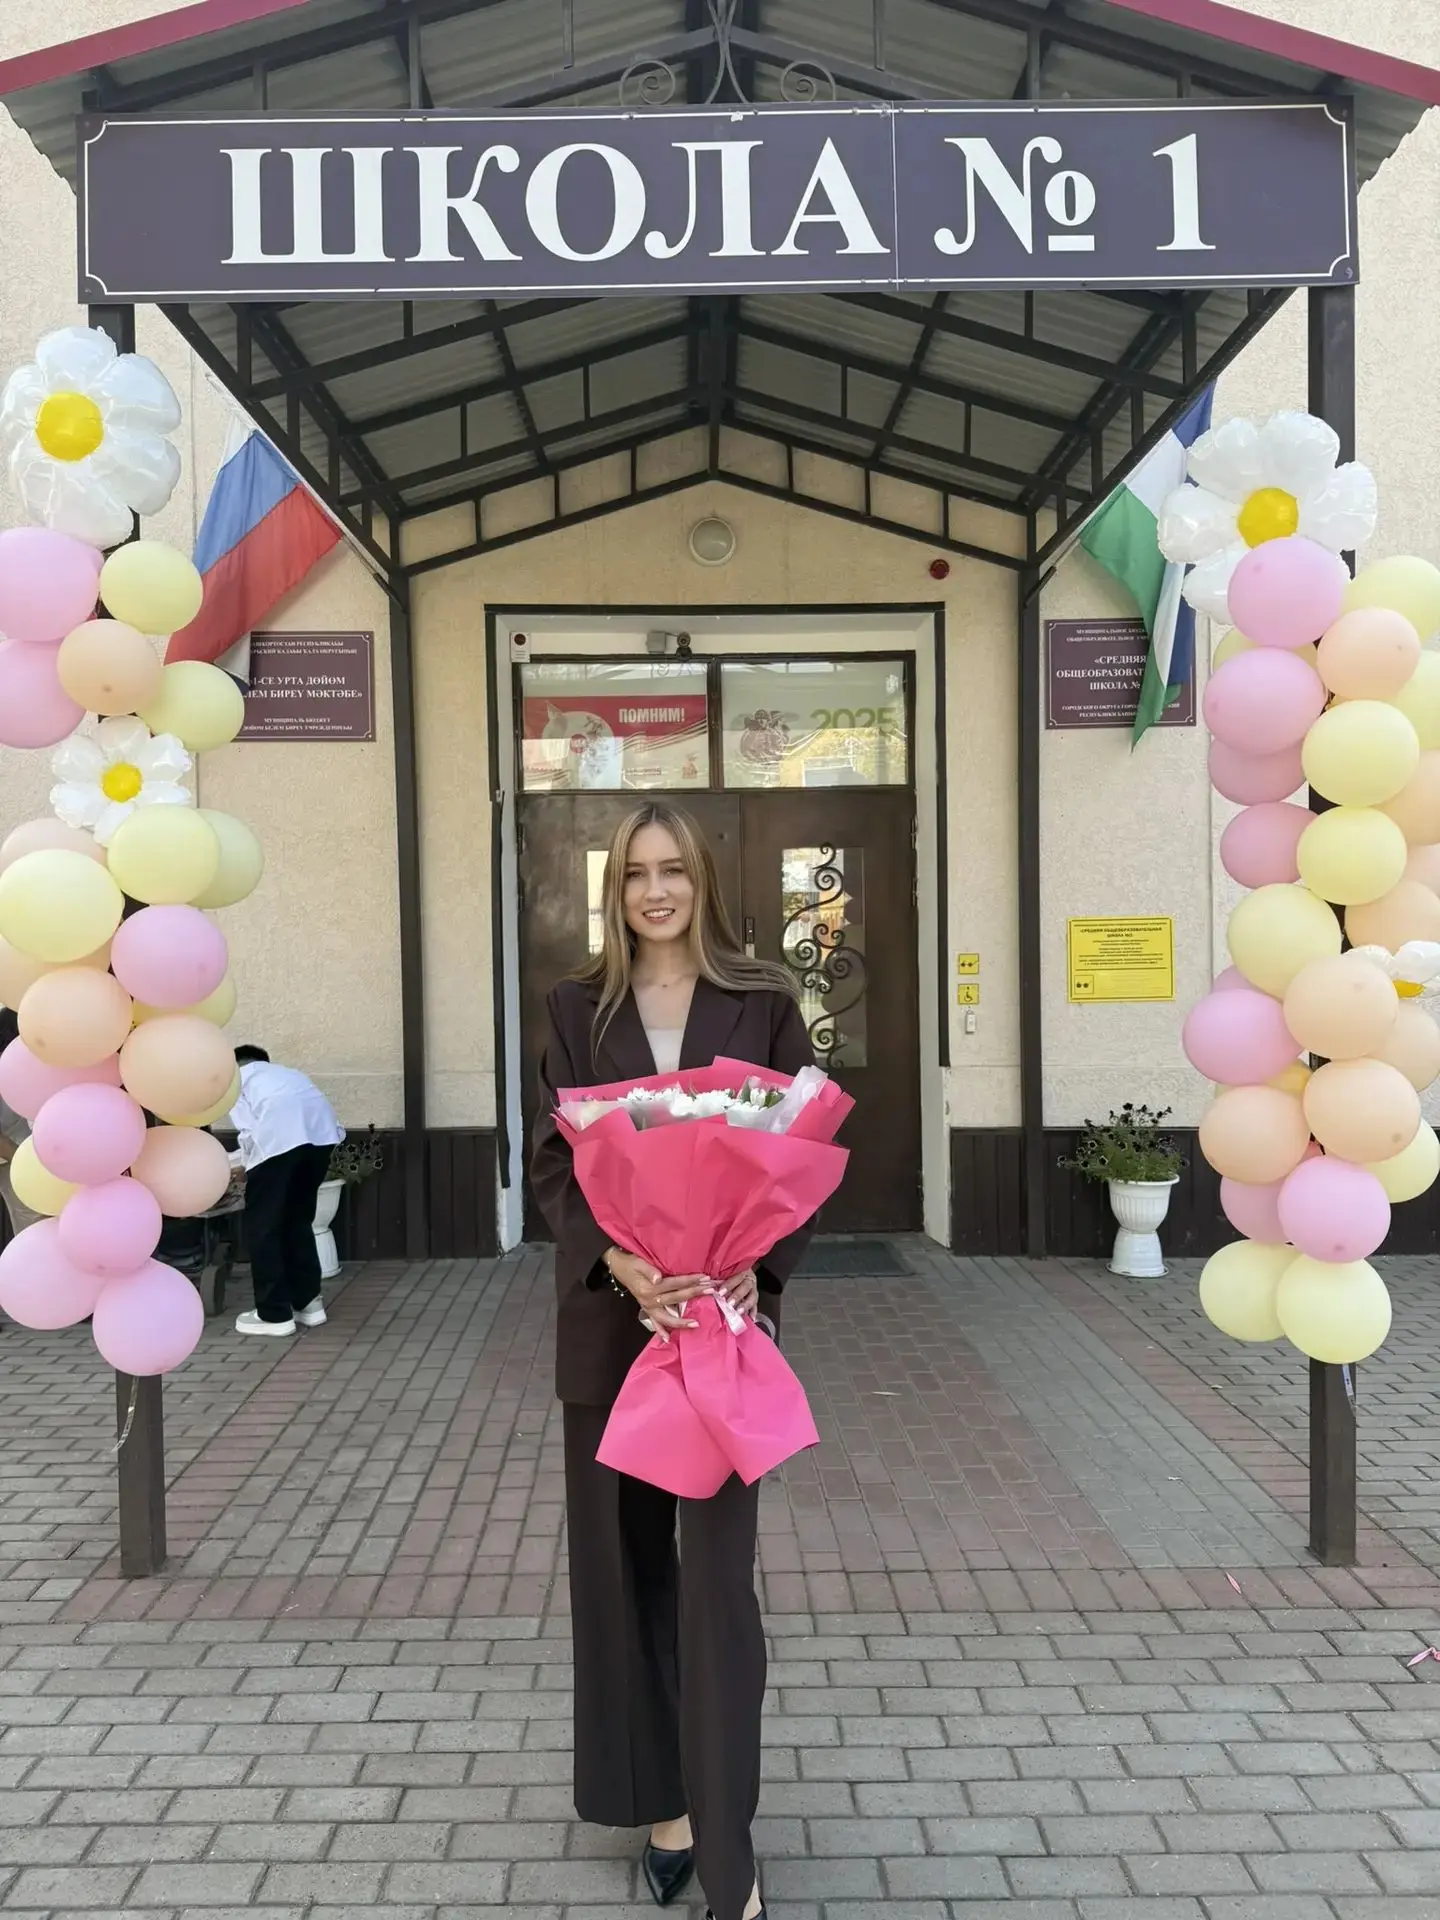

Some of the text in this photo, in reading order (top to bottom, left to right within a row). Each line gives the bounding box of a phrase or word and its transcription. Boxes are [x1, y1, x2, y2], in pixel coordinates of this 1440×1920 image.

[219, 132, 1217, 265] ШКОЛА № 1
[1094, 655, 1146, 664] «СРЕДНЯЯ
[1056, 668, 1143, 678] ОБЩЕОБРАЗОВАТ
[277, 676, 304, 685] УРТА
[1090, 681, 1128, 690] ШКОЛА
[619, 707, 686, 723] ПОМНИМ!
[810, 707, 899, 734] 2025
